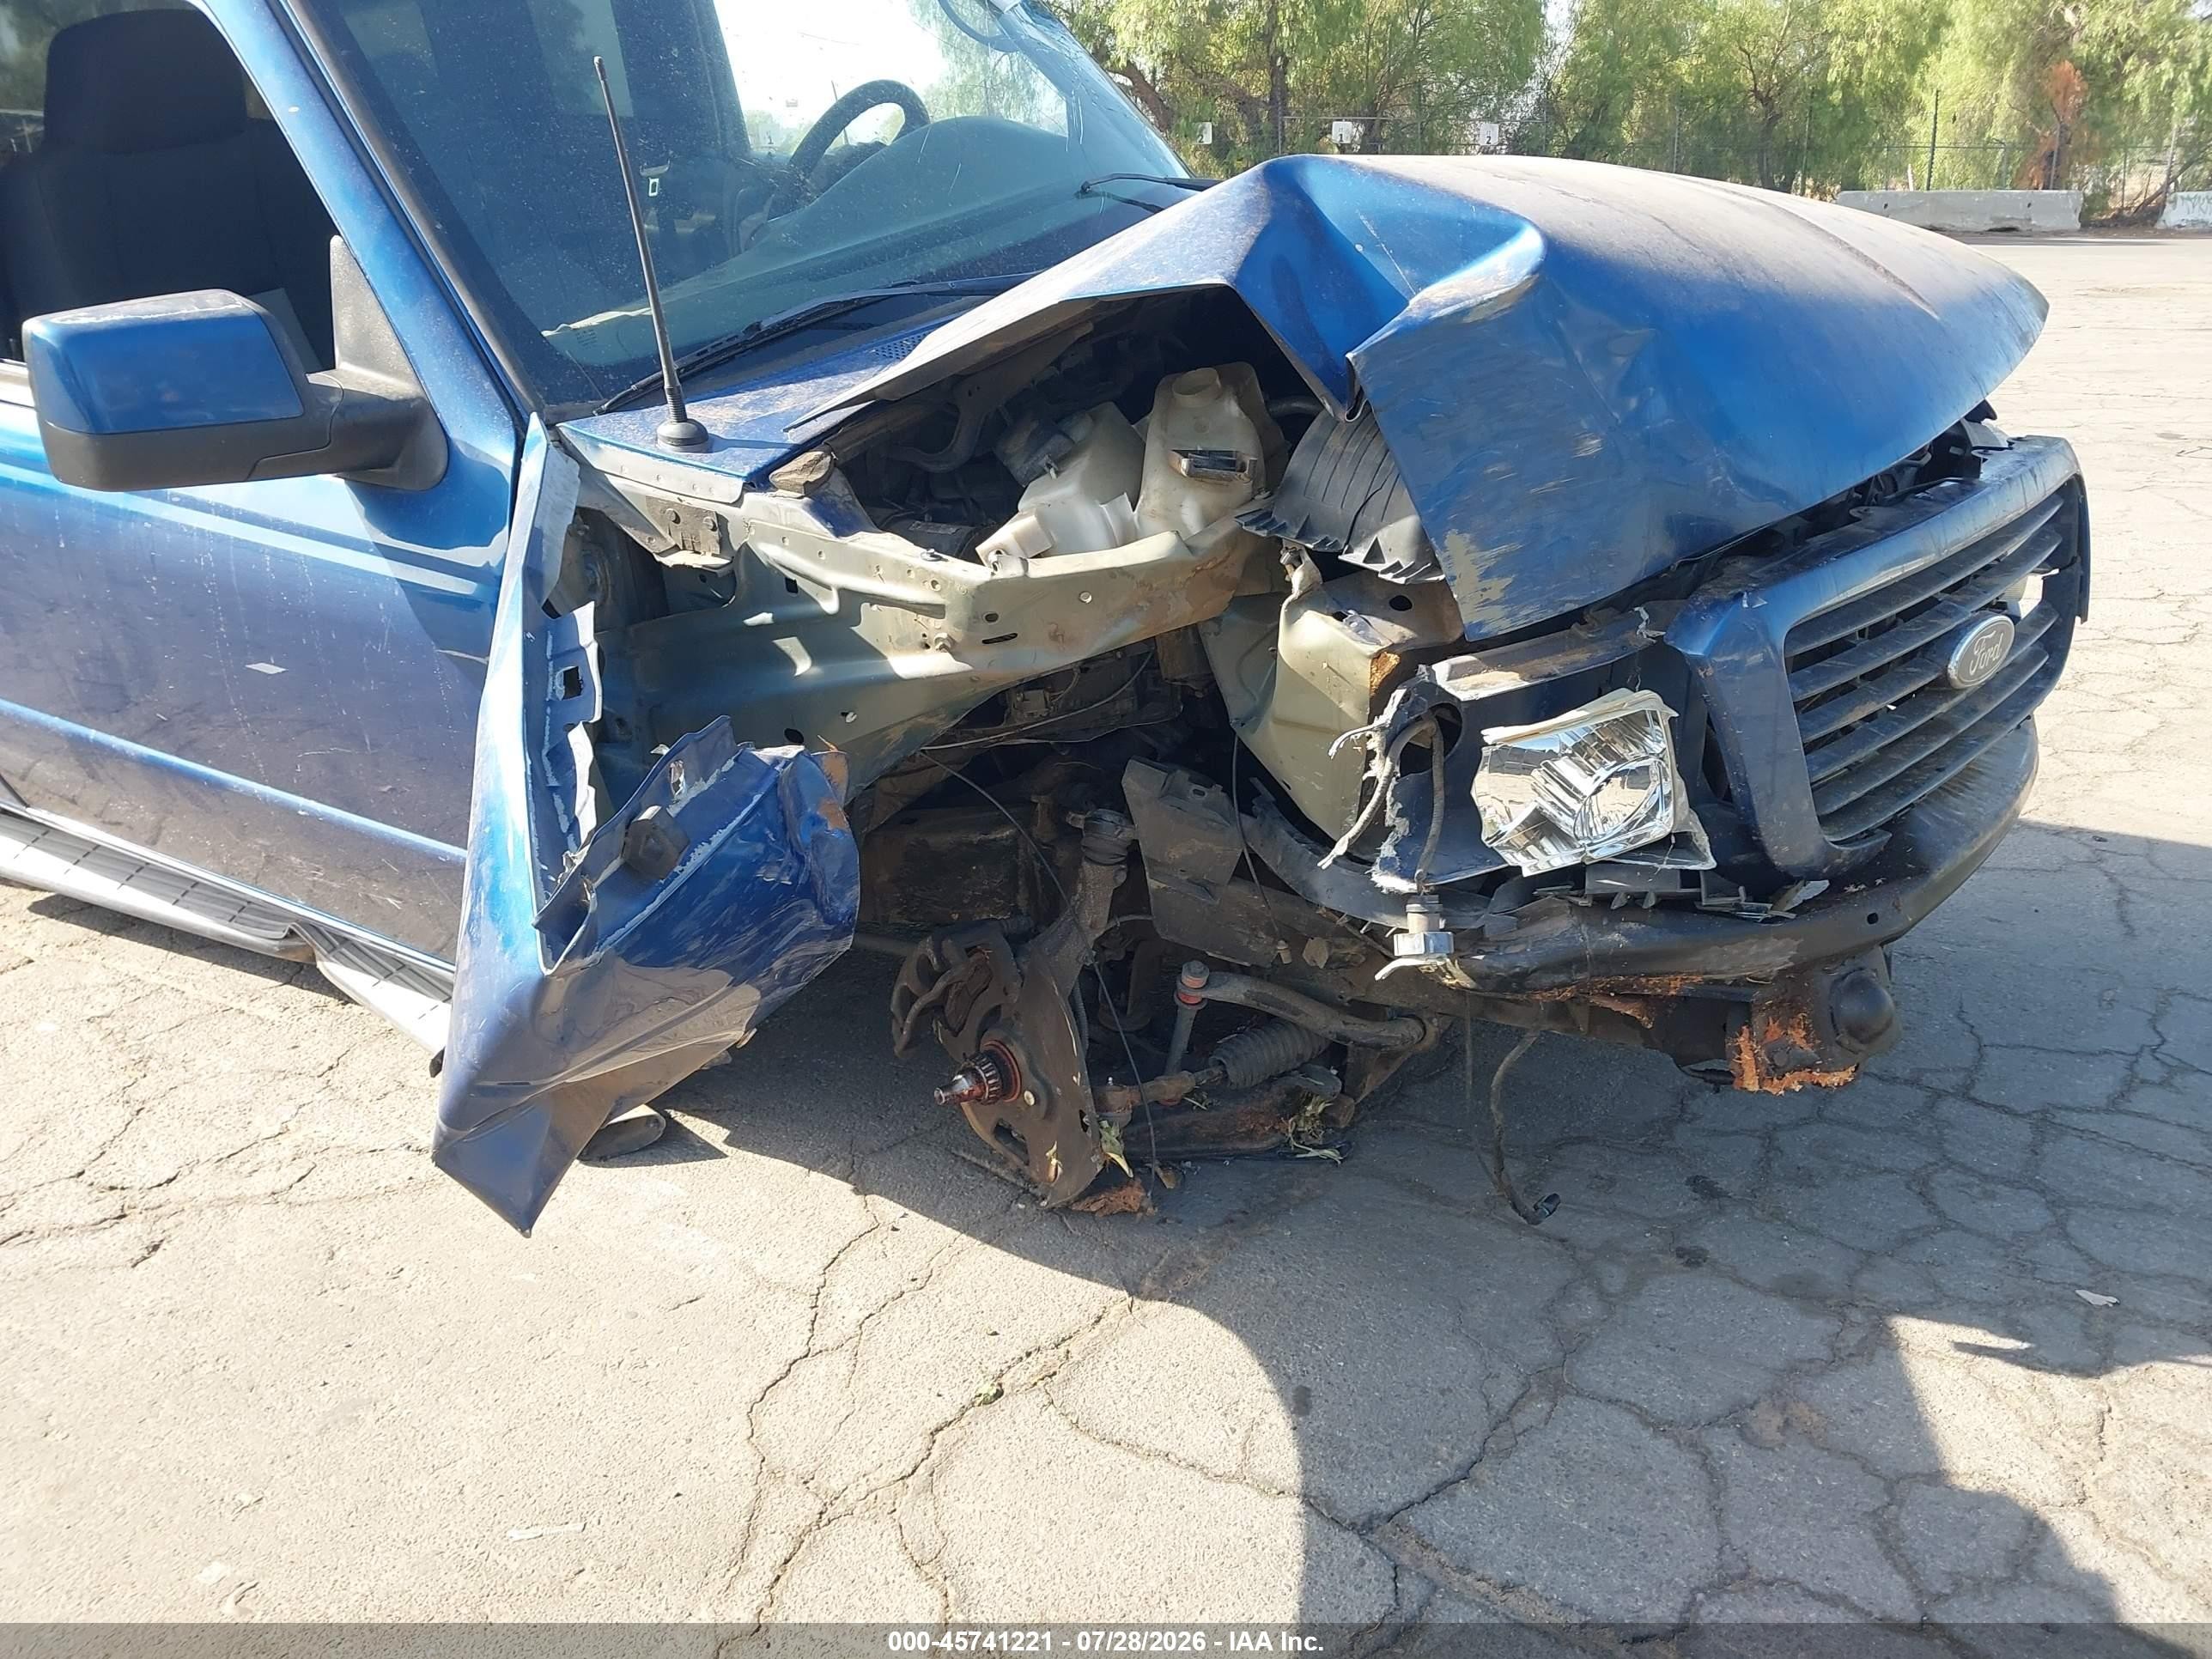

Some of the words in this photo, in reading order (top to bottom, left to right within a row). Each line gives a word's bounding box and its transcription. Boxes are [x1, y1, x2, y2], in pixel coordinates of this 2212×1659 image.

[1197, 134, 1204, 143] 2
[1338, 133, 1344, 143] 1
[1486, 136, 1492, 144] 2
[1969, 630, 2003, 676] Ford
